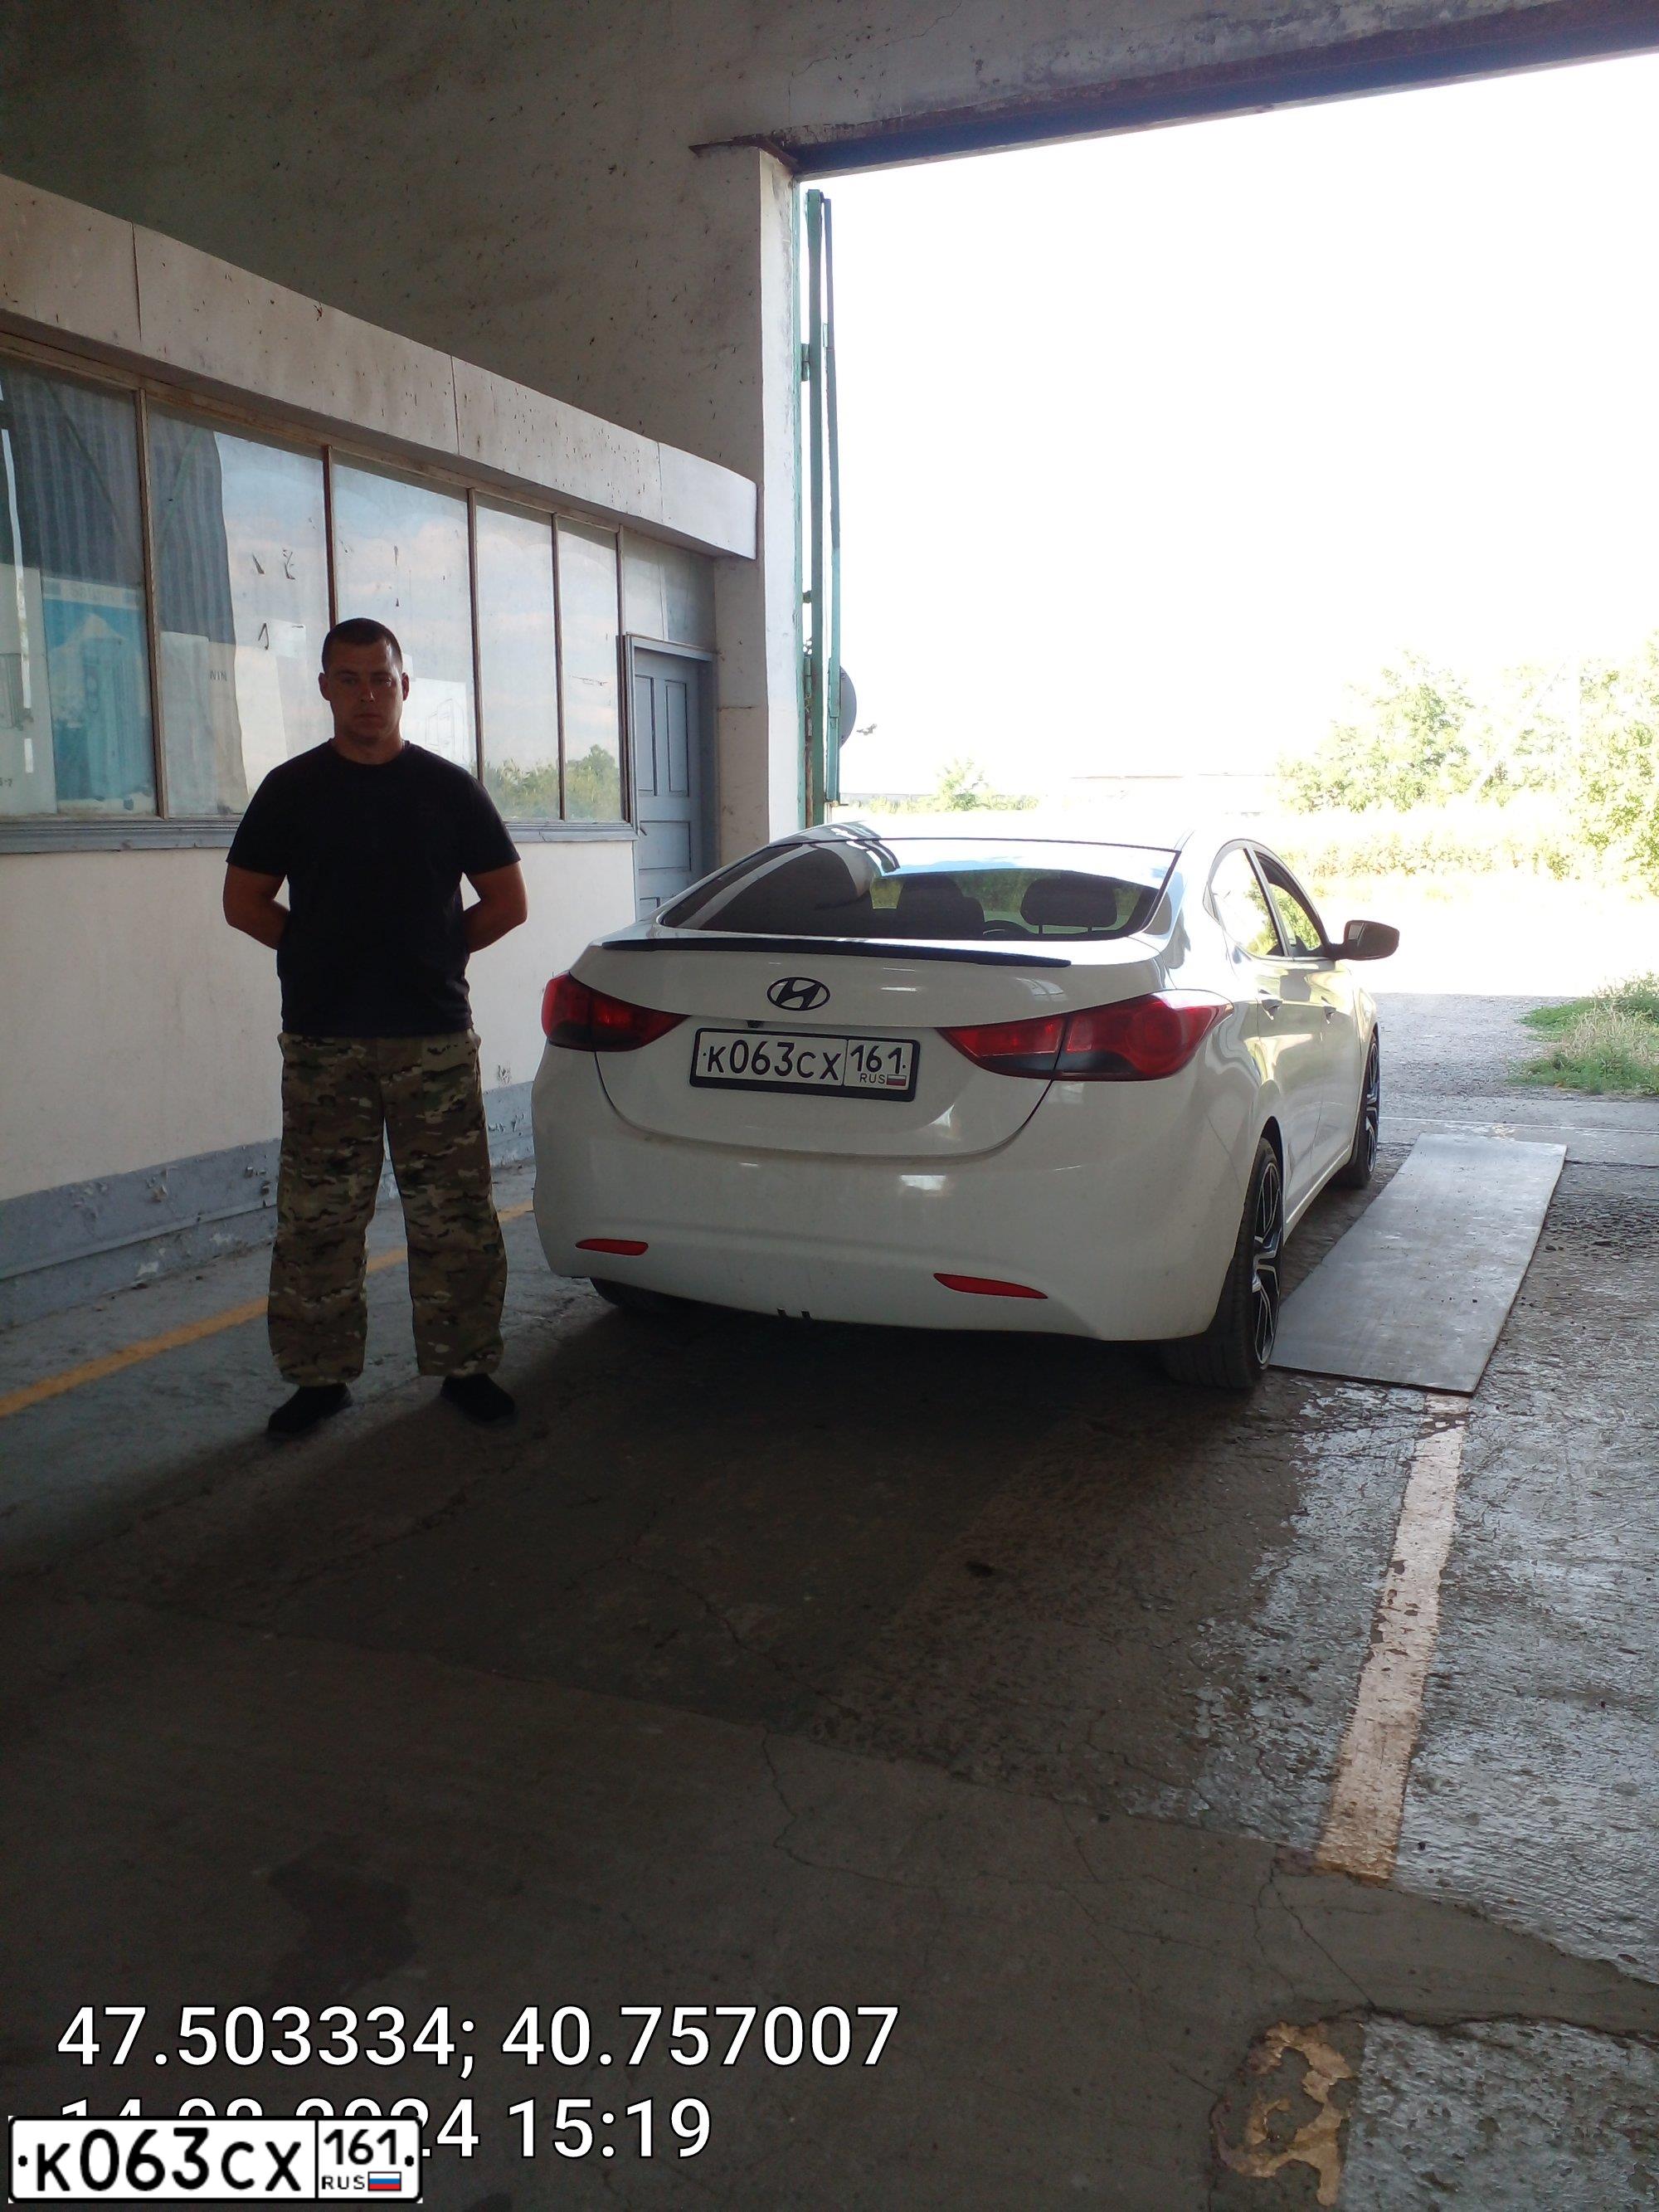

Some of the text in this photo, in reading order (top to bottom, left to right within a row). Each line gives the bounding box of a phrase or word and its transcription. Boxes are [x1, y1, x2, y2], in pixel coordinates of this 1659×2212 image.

[707, 1040, 902, 1081] К063СХ 161
[859, 1073, 886, 1084] RUS
